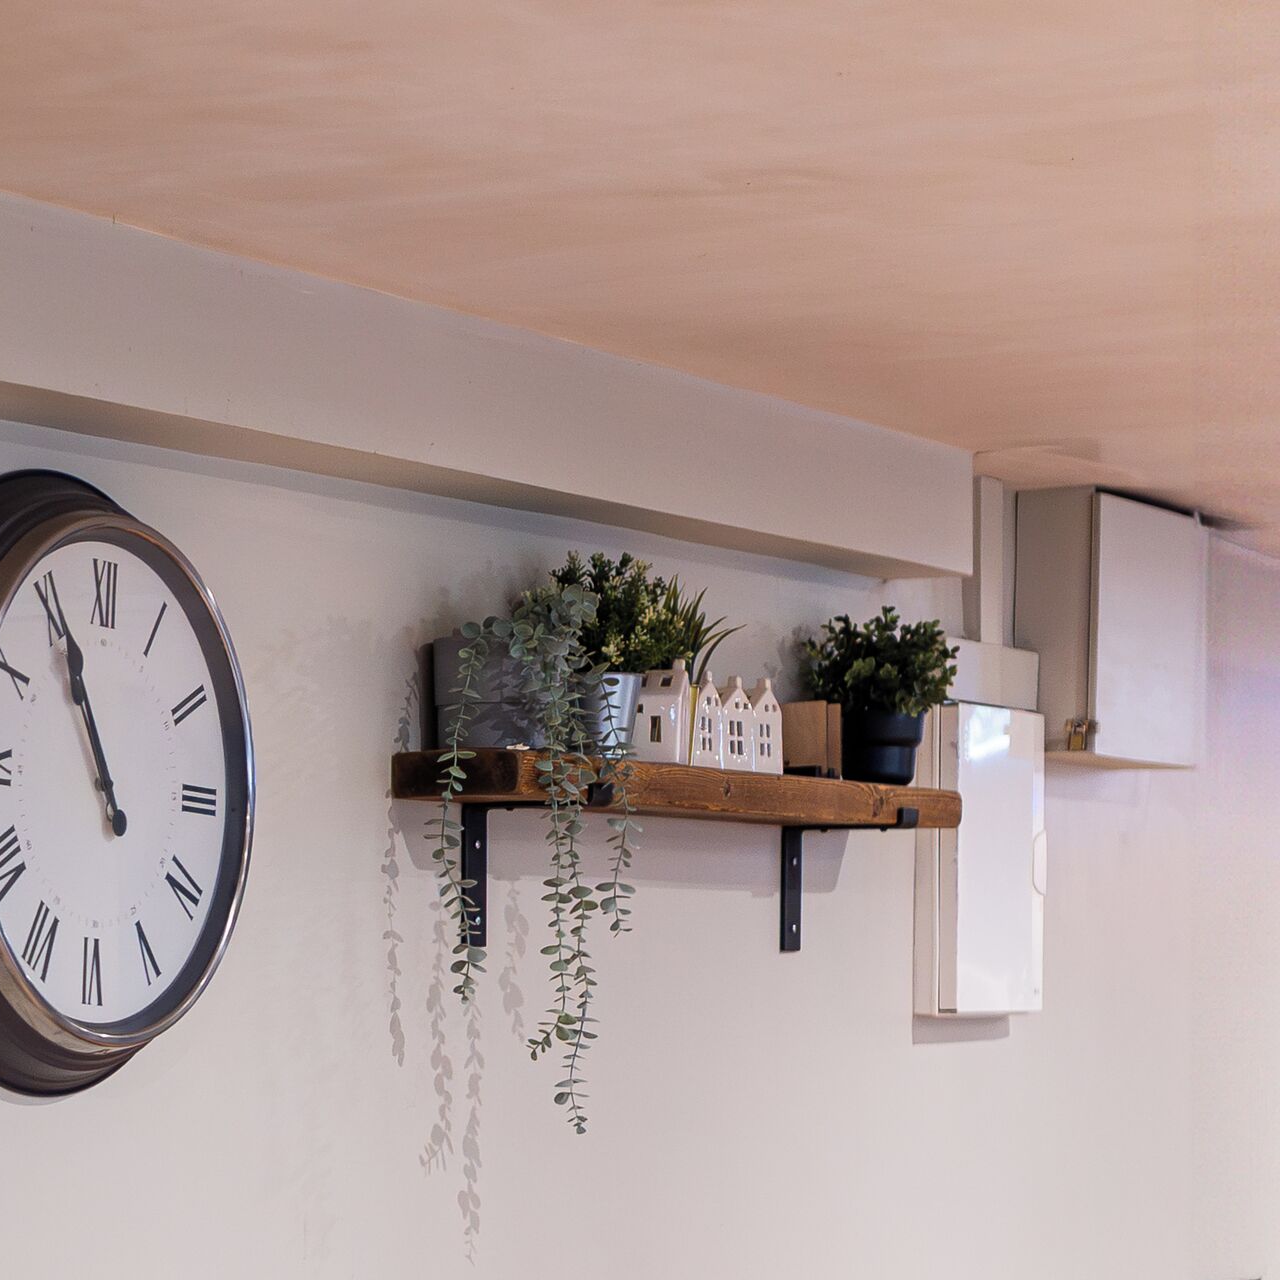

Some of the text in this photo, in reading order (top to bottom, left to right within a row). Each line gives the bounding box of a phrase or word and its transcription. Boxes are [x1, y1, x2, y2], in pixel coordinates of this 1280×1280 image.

[90, 558, 118, 629] XII
[171, 684, 207, 726] II
[181, 784, 216, 816] III
[165, 854, 203, 921] IV
[21, 900, 60, 983] VII
[82, 936, 103, 1007] VI
[134, 920, 162, 986] V
